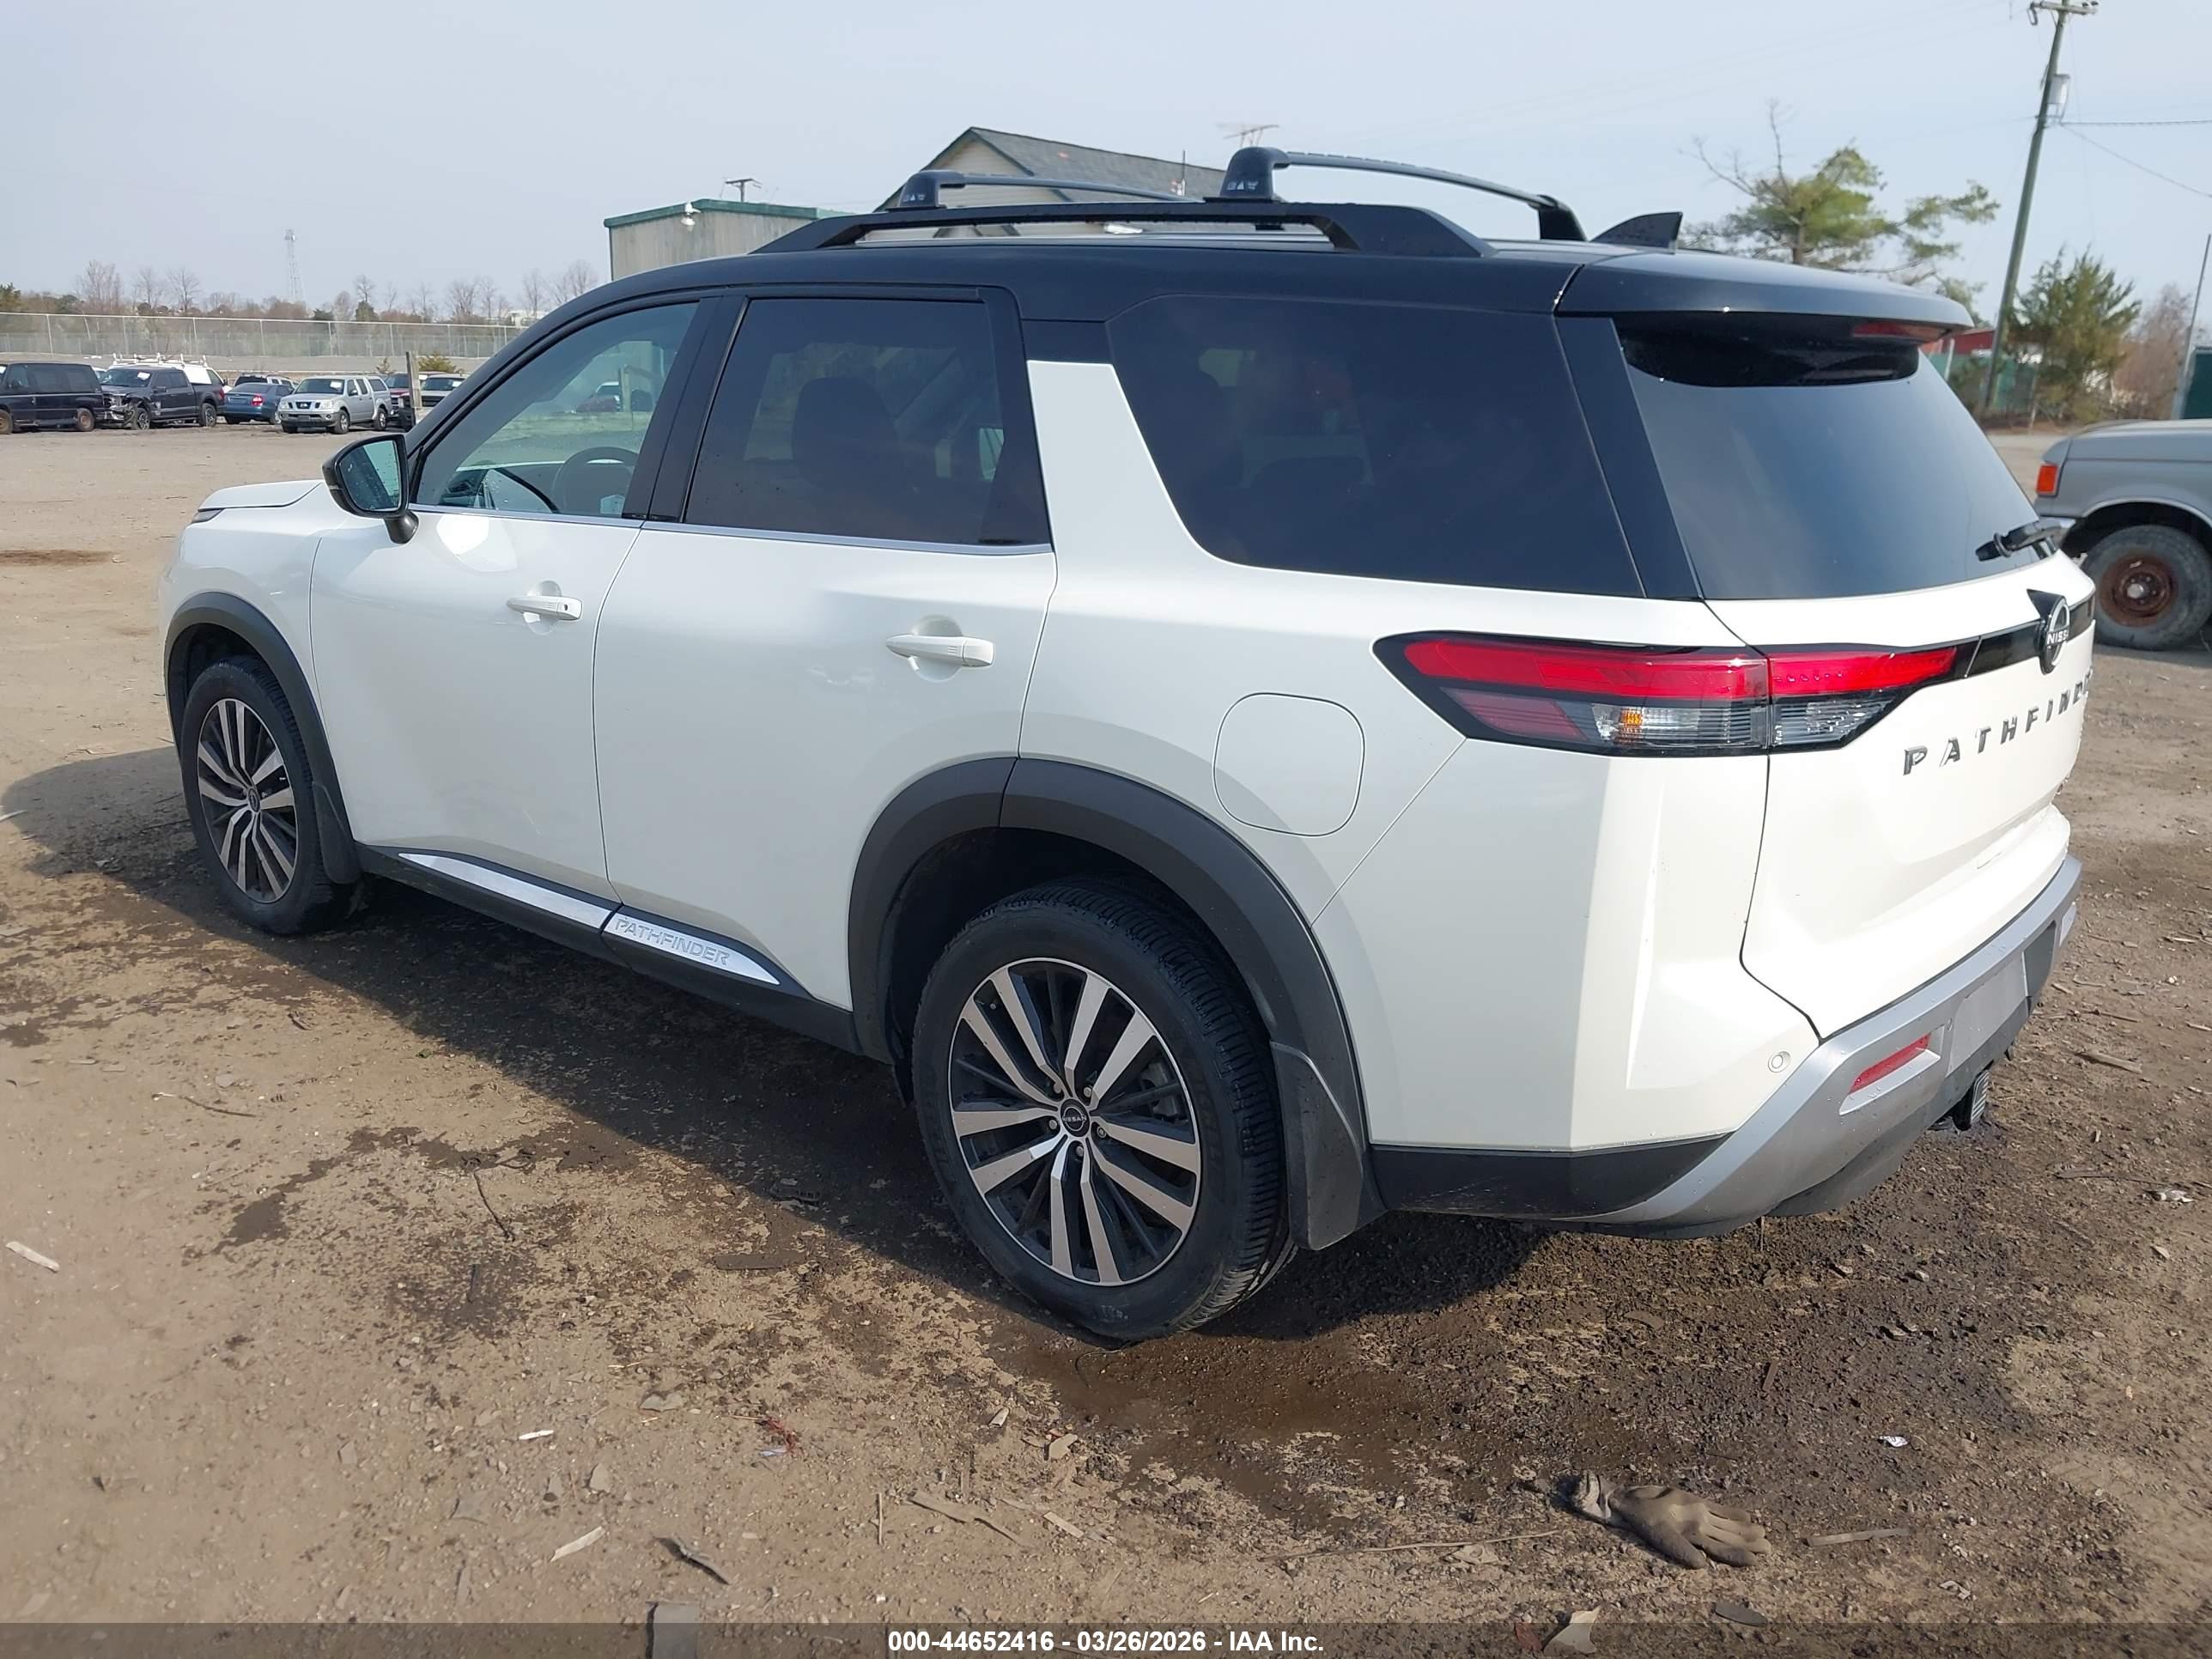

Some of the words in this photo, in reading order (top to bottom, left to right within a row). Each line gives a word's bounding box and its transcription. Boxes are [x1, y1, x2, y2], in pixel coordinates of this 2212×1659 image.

[2046, 629, 2069, 645] NISS
[1903, 667, 2093, 776] PATHFINDE
[615, 918, 730, 966] PATHFINDER
